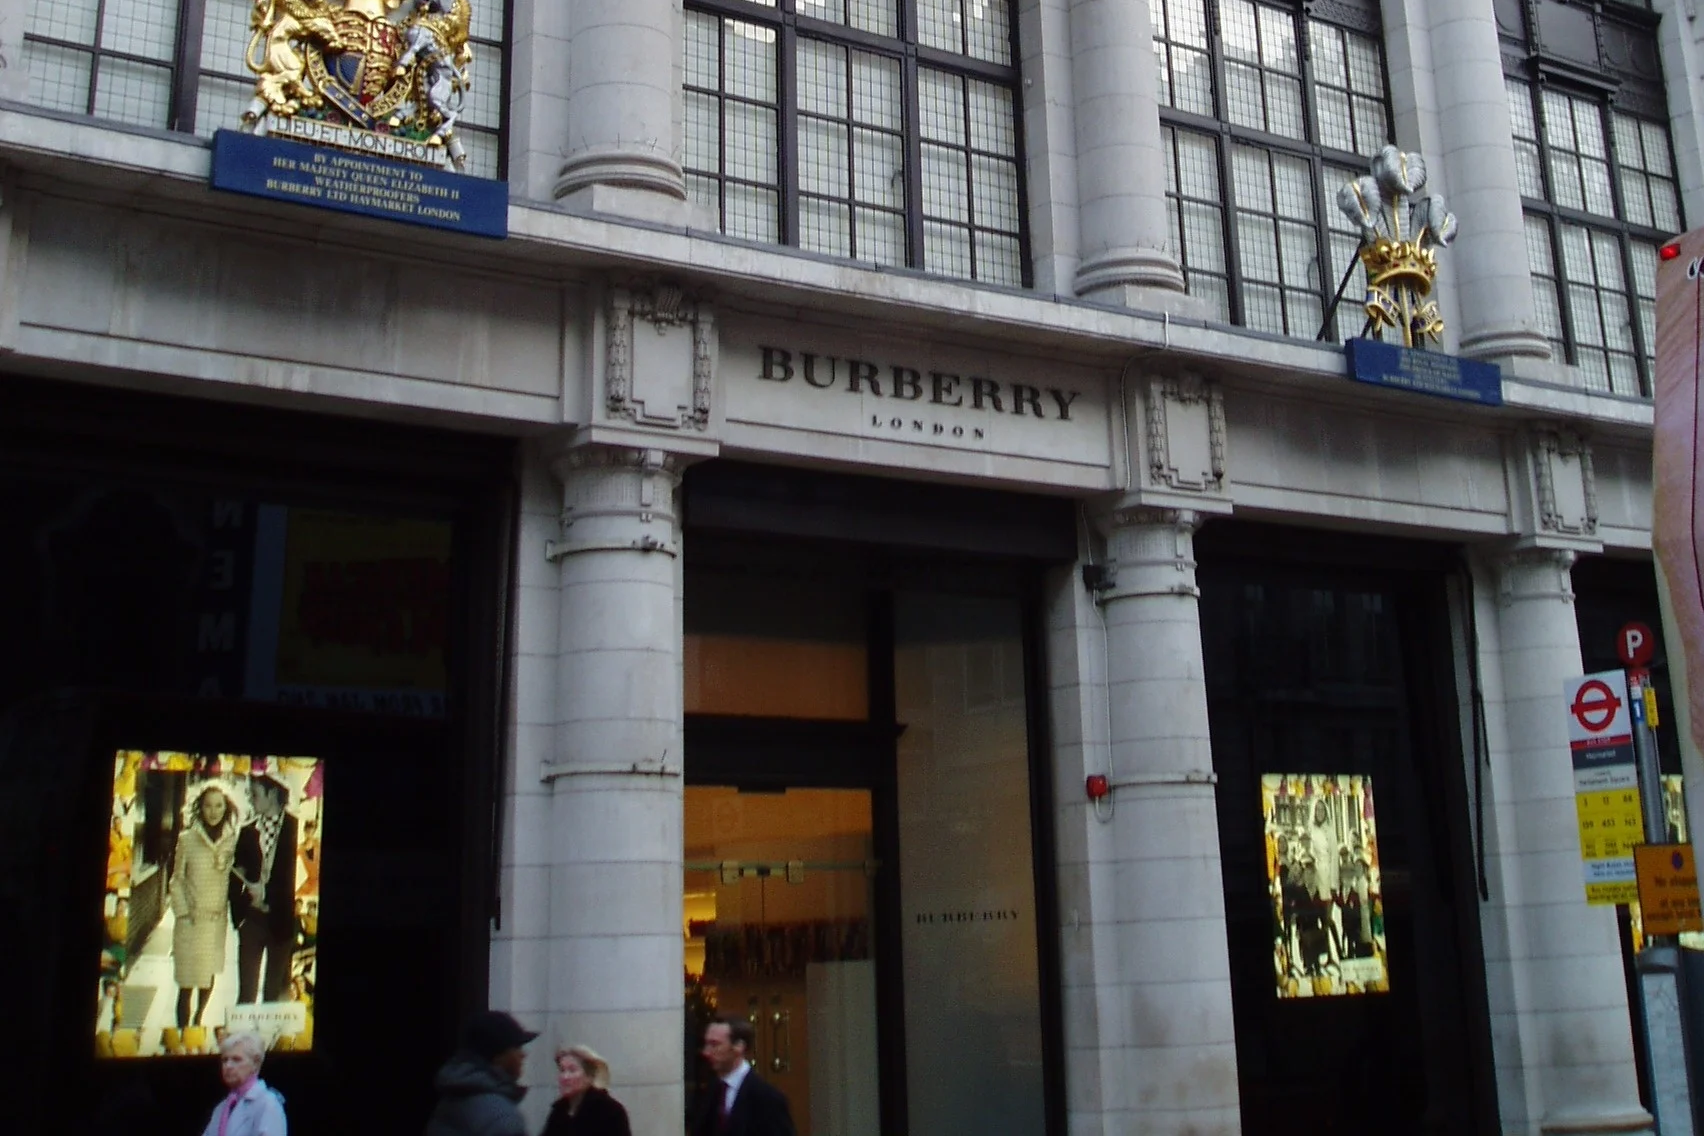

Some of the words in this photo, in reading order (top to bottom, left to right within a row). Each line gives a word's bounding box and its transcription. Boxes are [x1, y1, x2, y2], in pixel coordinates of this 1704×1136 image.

[276, 117, 318, 138] DIEU
[320, 126, 342, 141] ET
[349, 131, 387, 152] MON
[393, 143, 438, 162] DROIT
[273, 156, 296, 171] HER
[299, 161, 348, 180] MAJESTY
[350, 171, 388, 187] QUEEN
[391, 179, 449, 198] ELIZABETH
[451, 189, 460, 200] II
[314, 152, 326, 165] BY
[331, 156, 406, 179] APPOINTMENT
[410, 170, 424, 182] TO
[266, 178, 323, 198] BURBERRY
[326, 189, 348, 202] LTD
[350, 194, 414, 214] HAYMARKET
[417, 205, 461, 222] LONDON
[314, 175, 421, 204] WEATHERPROOFERS
[758, 345, 1083, 421] BURBERRY
[871, 414, 985, 441] LONDON
[1625, 629, 1643, 659] P
